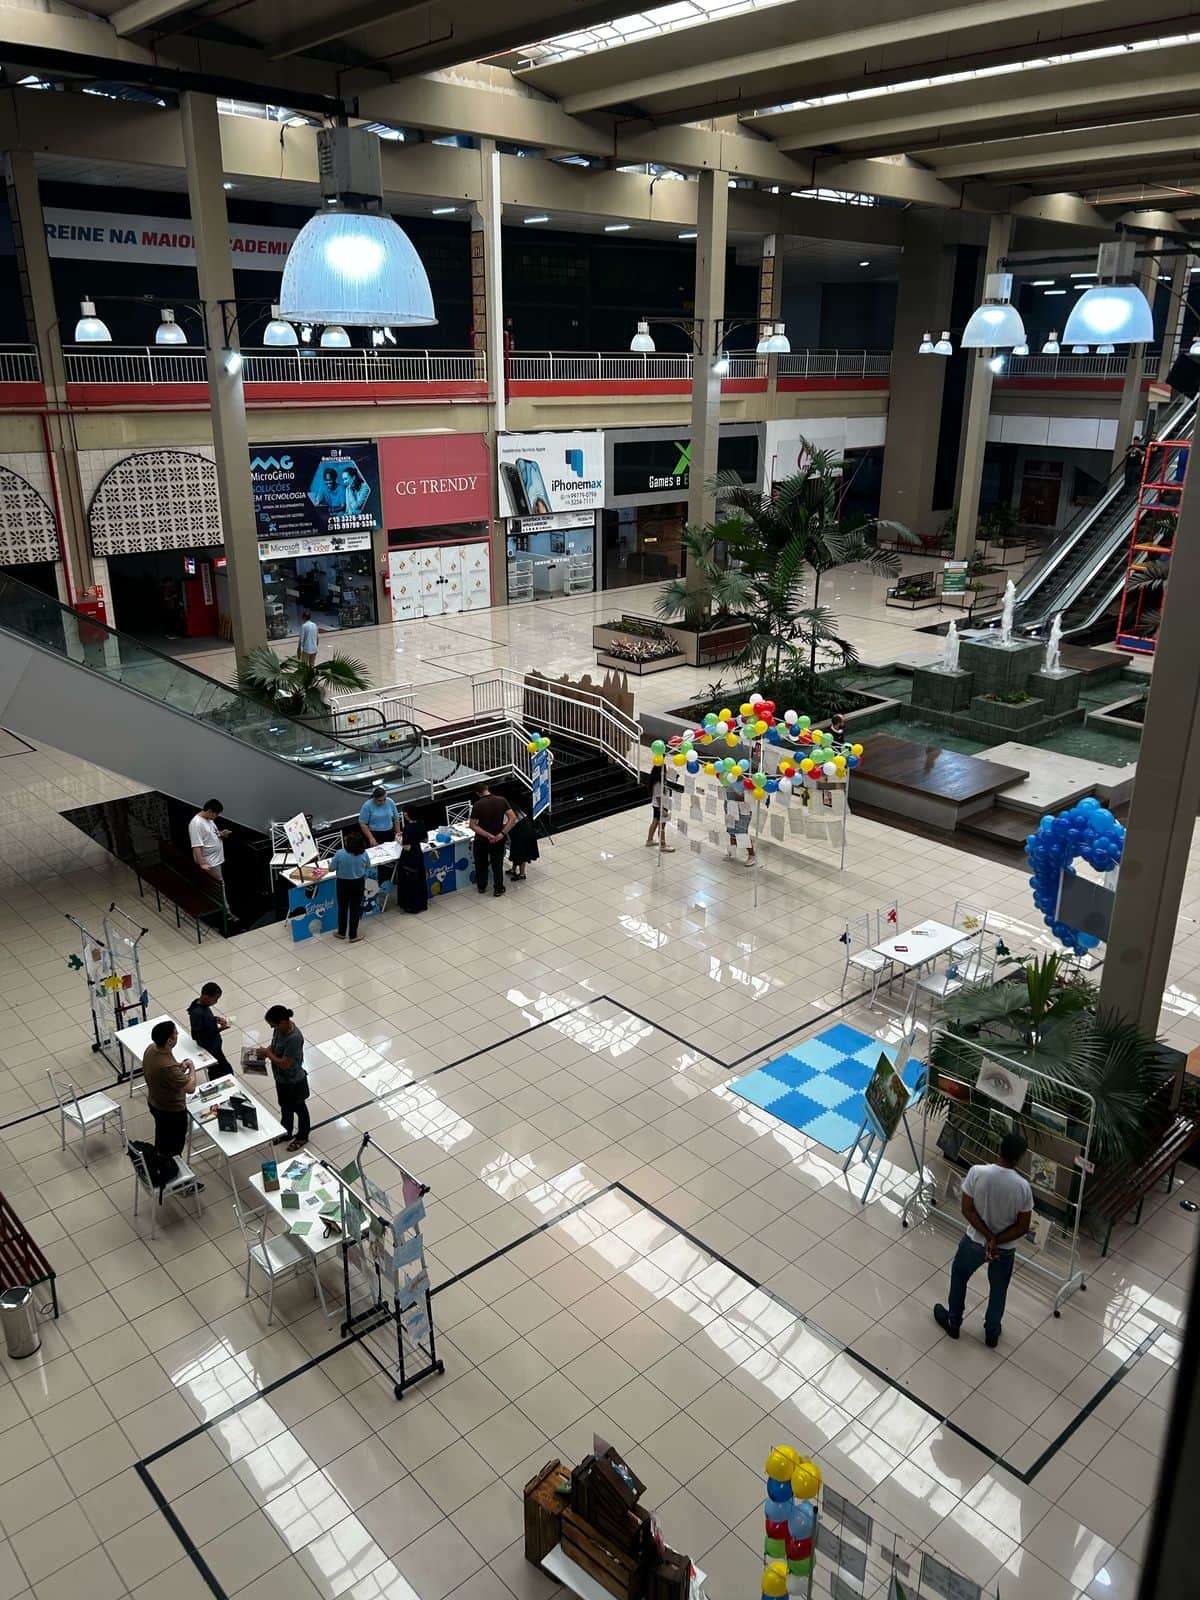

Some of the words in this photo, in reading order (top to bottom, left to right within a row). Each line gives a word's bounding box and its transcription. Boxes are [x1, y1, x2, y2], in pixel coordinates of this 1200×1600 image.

[109, 227, 137, 245] NA
[141, 231, 195, 249] MAIO
[229, 238, 294, 256] ADEMI
[250, 470, 296, 482] MicroGênio
[649, 475, 674, 489] Games
[675, 477, 681, 486] e
[252, 482, 292, 494] OLUÇÕES
[395, 480, 417, 496] CG
[420, 476, 478, 494] TRENDY
[551, 479, 602, 492] iPhonemax
[264, 491, 307, 501] TECNOLOGIA
[270, 542, 300, 553] Microsoft
